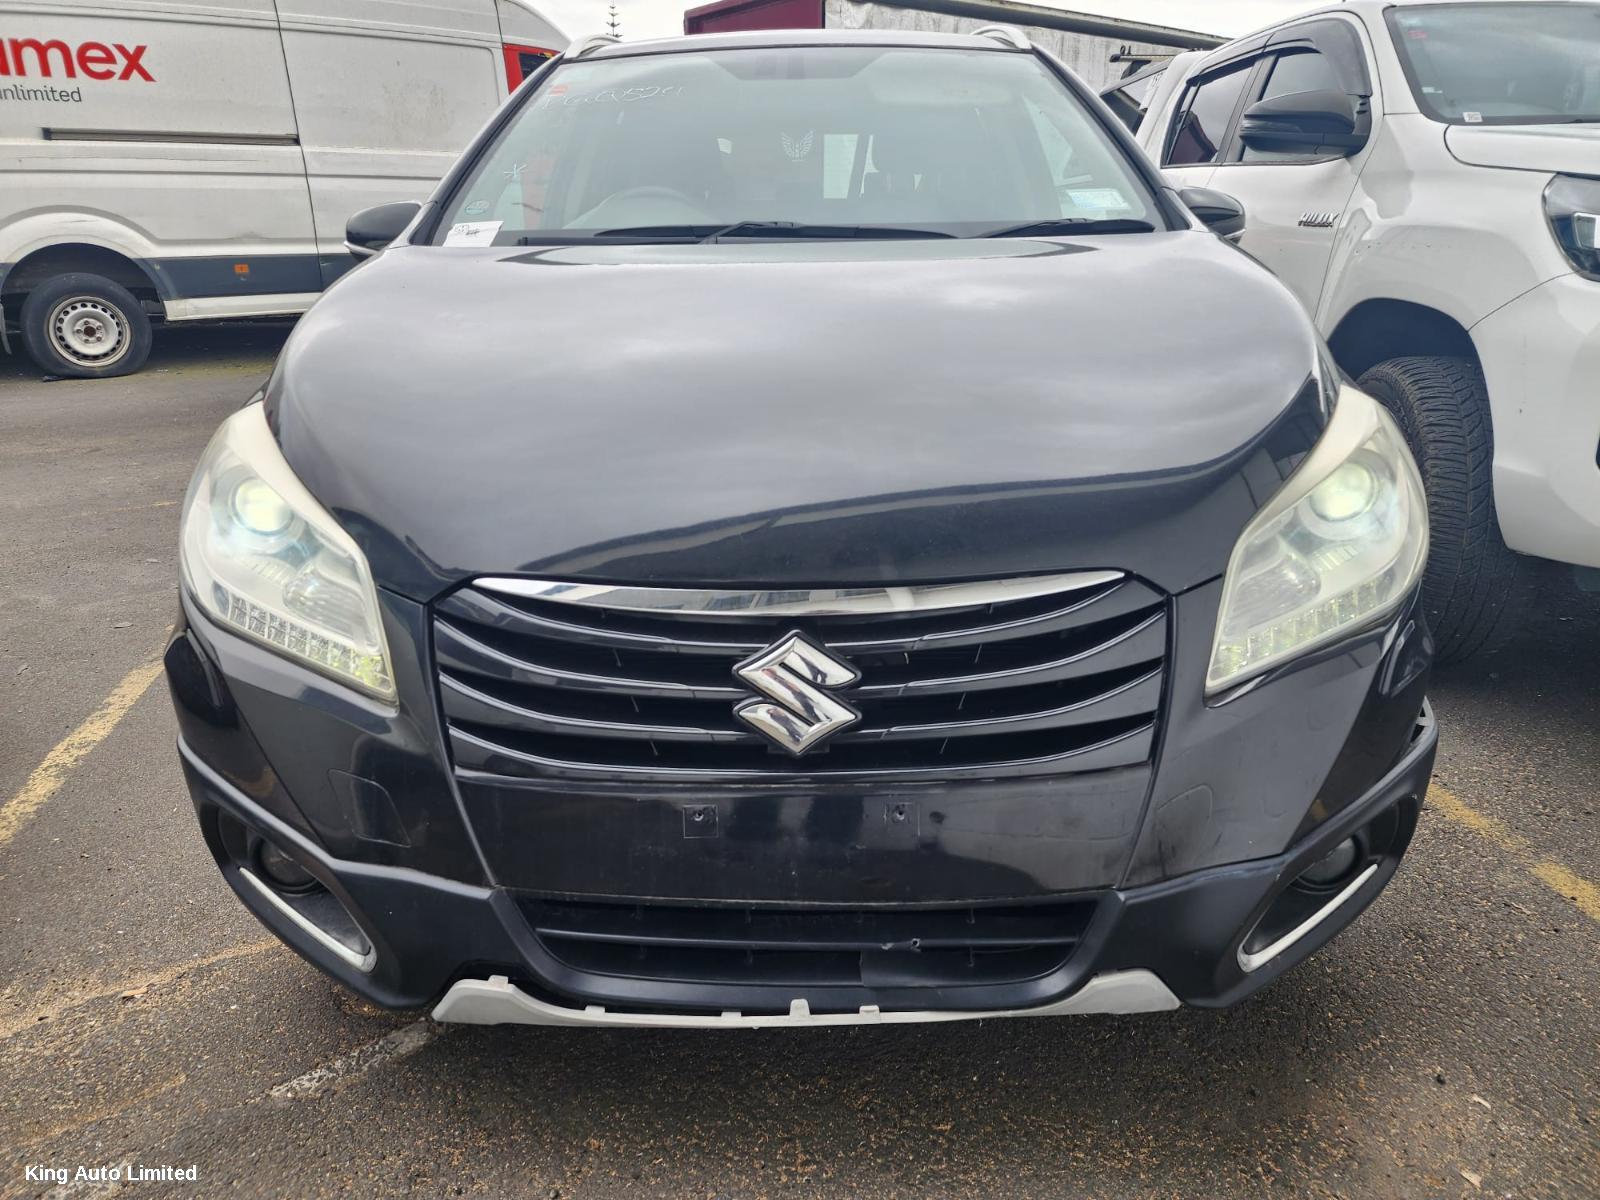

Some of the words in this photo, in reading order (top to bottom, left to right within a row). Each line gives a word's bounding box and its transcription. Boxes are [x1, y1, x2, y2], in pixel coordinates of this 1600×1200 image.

[0, 37, 157, 82] mex
[0, 84, 82, 103] nlimited
[1298, 211, 1340, 228] HILUX
